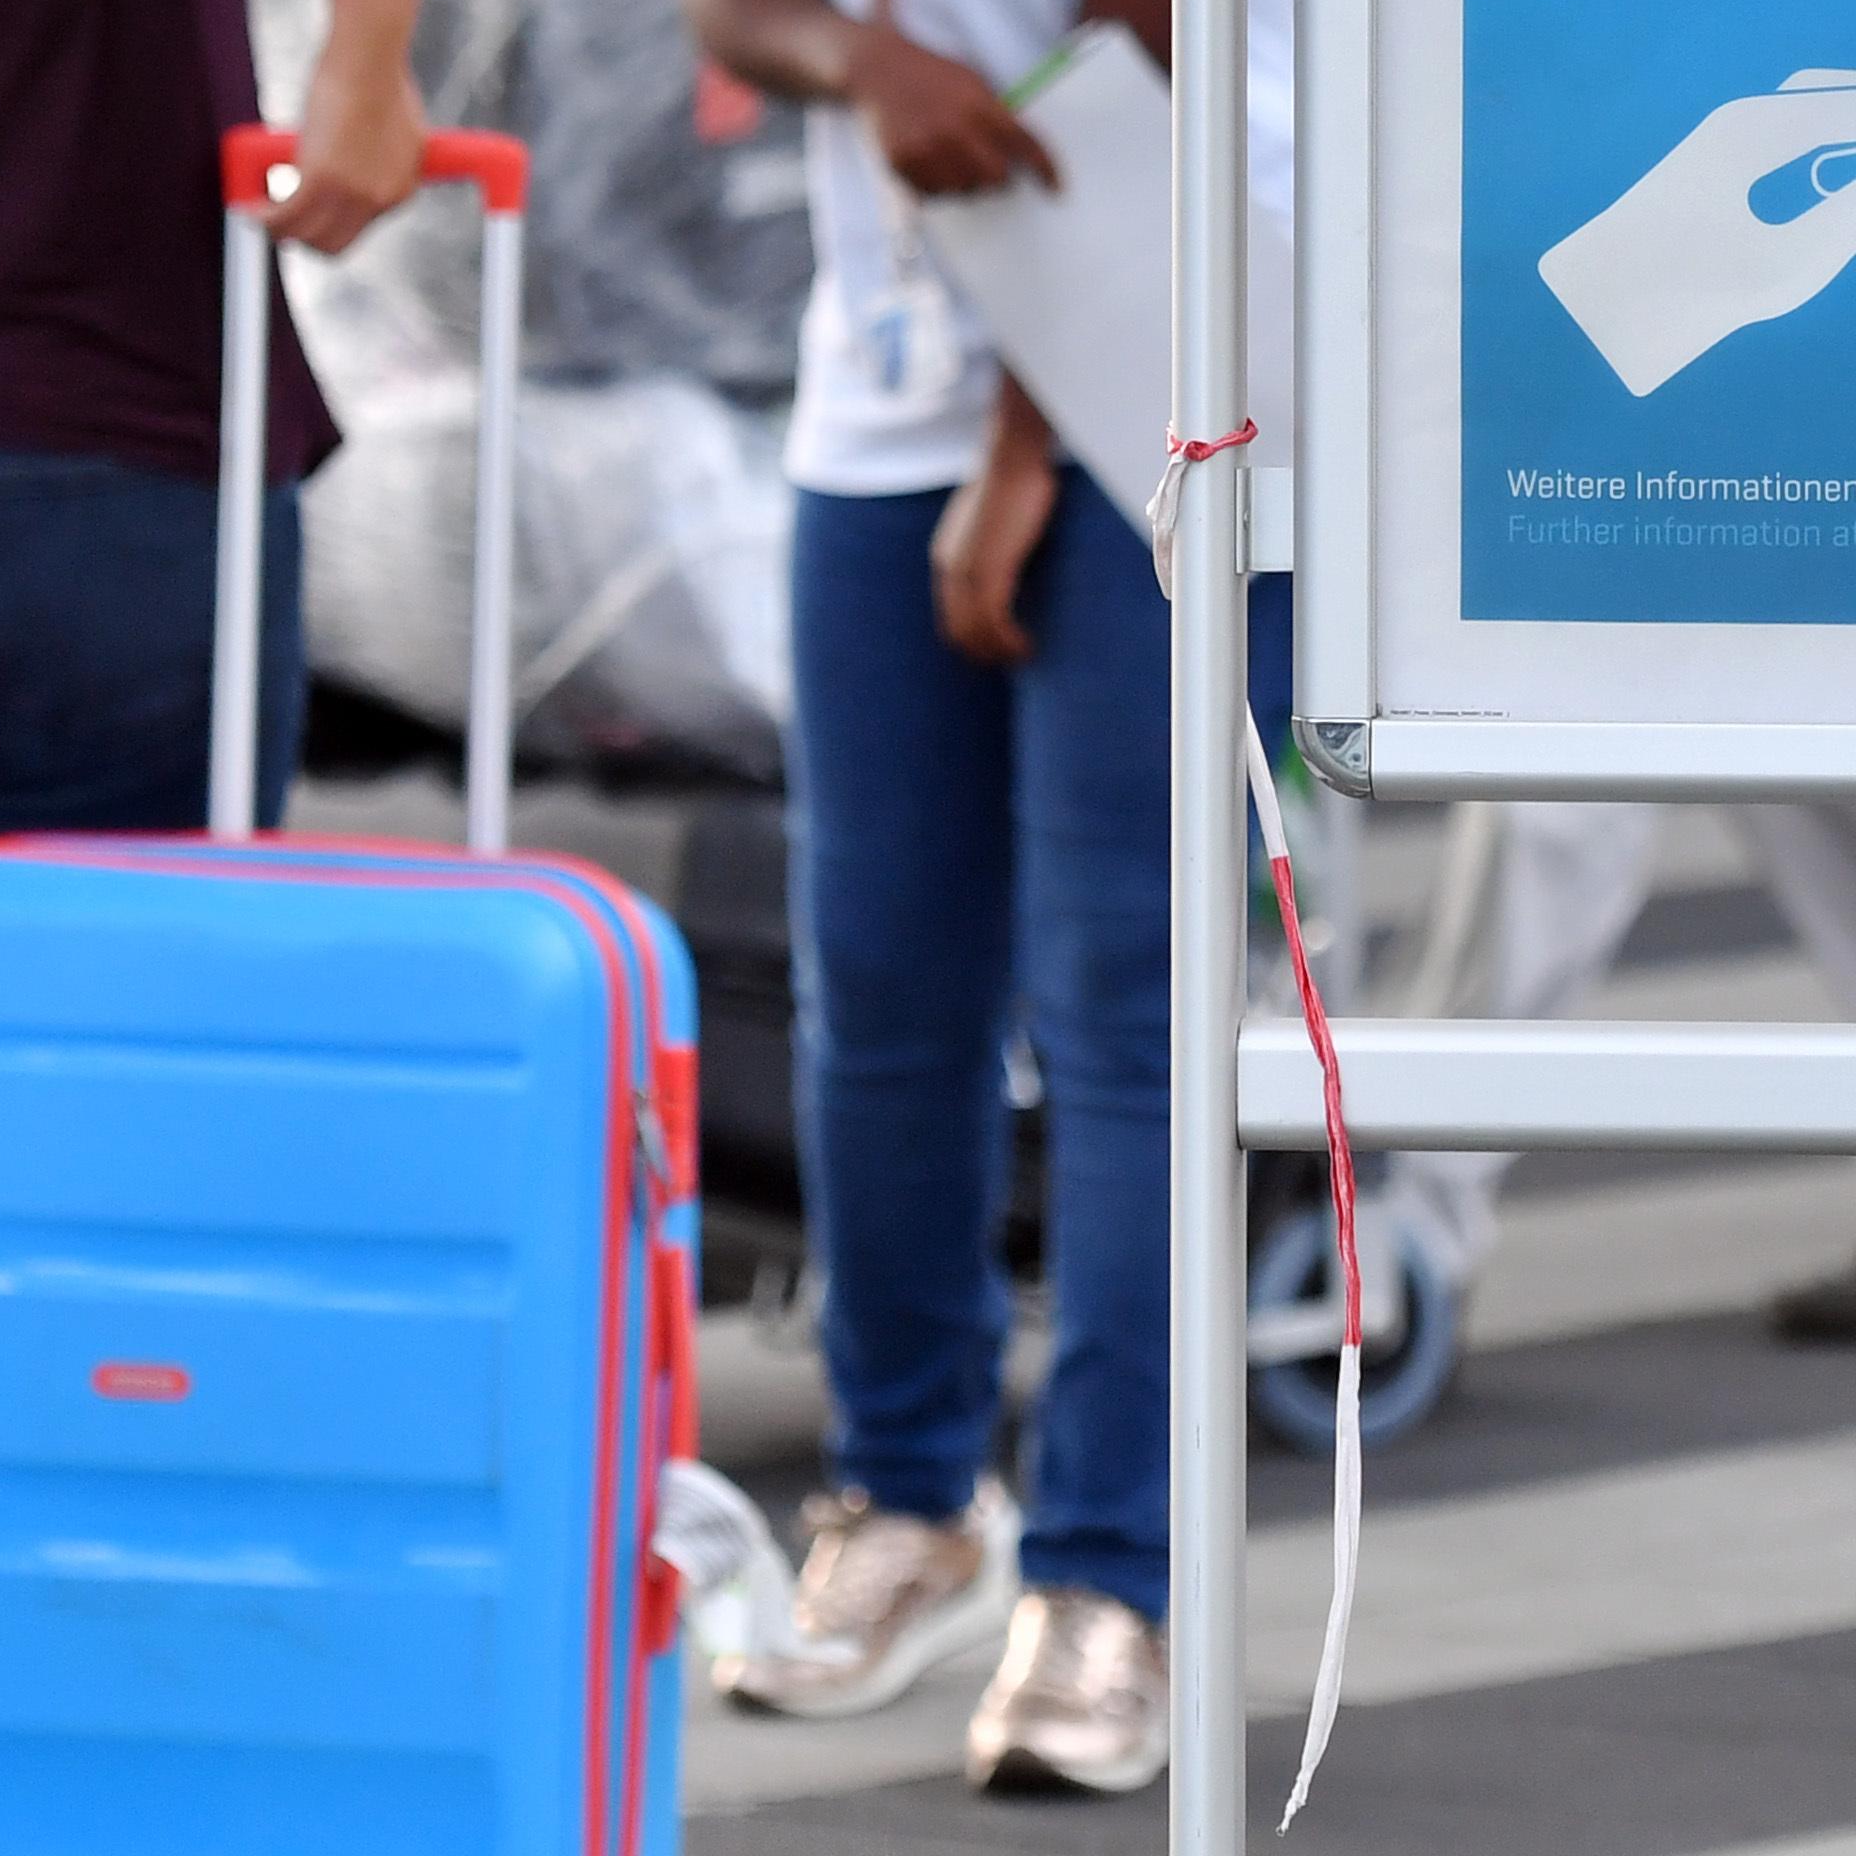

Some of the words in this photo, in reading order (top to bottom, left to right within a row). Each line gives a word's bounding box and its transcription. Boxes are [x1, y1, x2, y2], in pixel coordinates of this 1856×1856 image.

[1507, 469, 1627, 500] Weitere
[1508, 514, 1625, 546] Further
[1635, 516, 1823, 548] information
